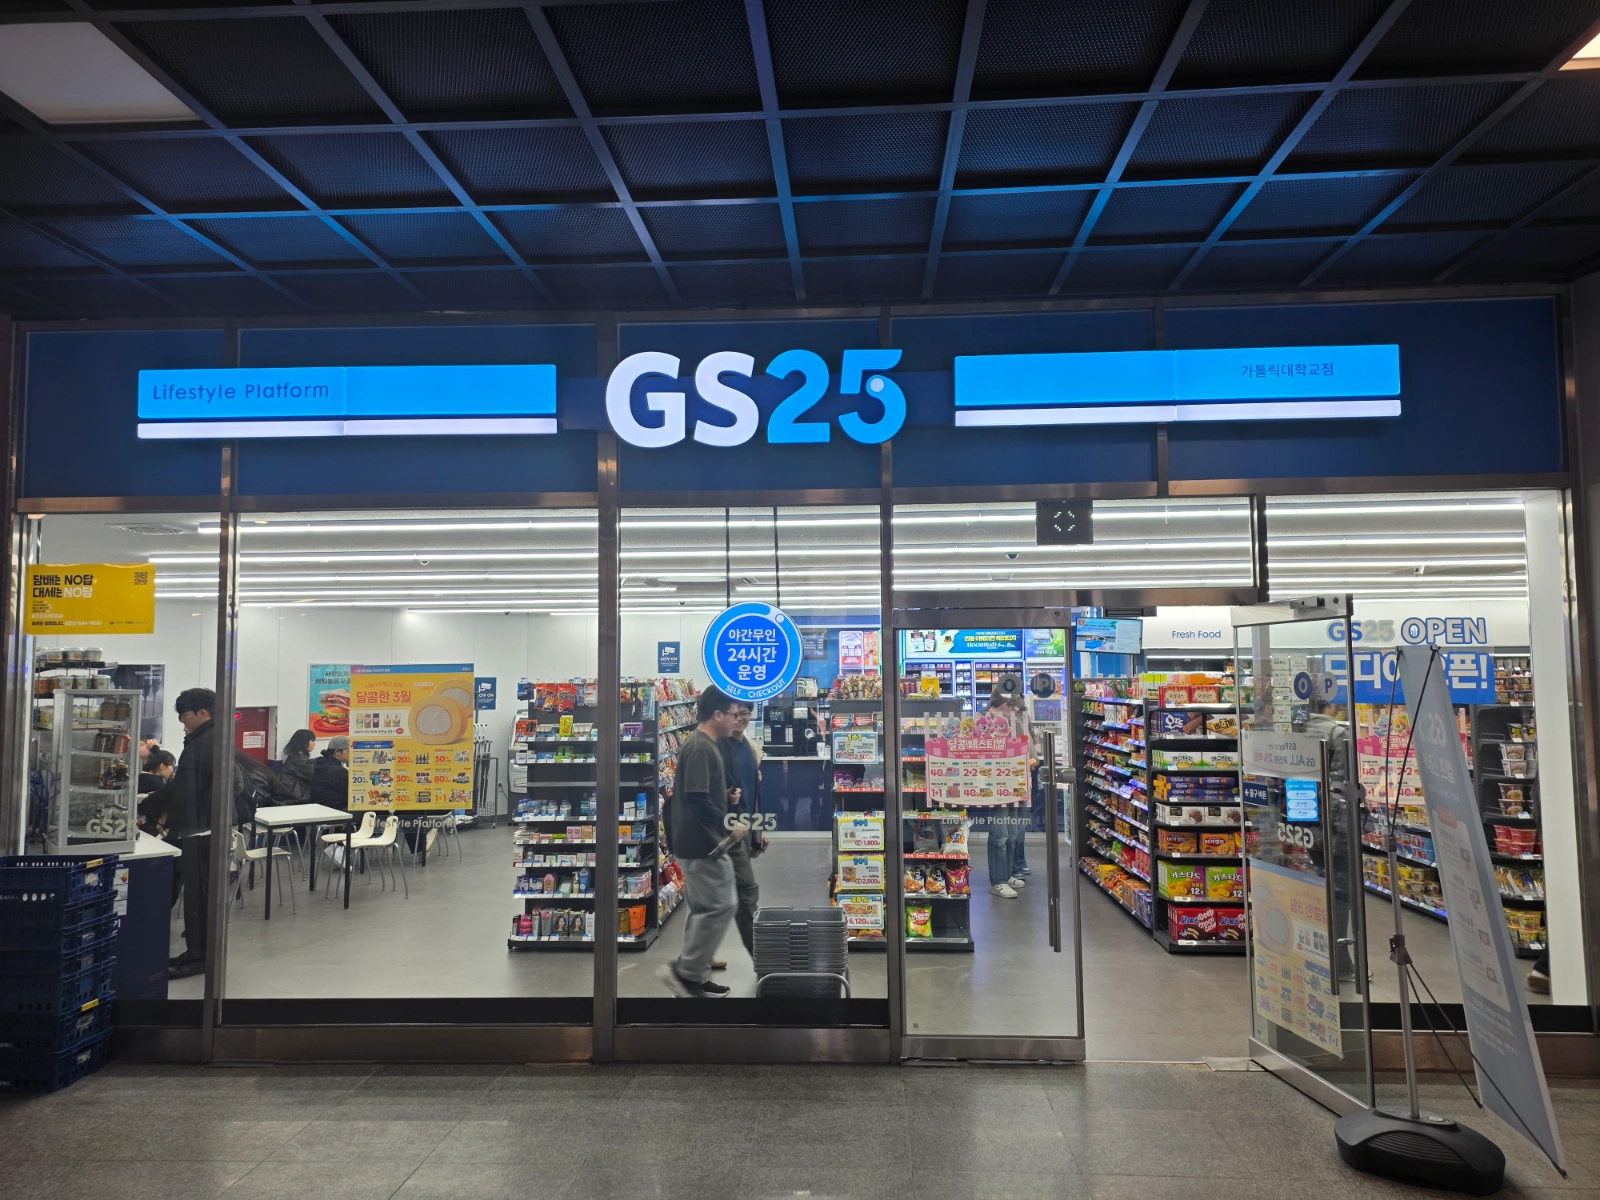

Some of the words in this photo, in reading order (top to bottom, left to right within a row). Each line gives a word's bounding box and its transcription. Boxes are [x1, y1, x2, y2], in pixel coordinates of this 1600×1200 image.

[1241, 362, 1334, 378] 가톨릭대학교점
[153, 384, 236, 405] Lifestyle
[244, 382, 330, 399] Platform
[605, 349, 907, 448] GS25
[33, 574, 61, 586] 담배는
[32, 587, 62, 598] 대세는
[728, 628, 776, 642] 야간무인
[1172, 630, 1195, 639] Fresh
[1198, 630, 1221, 638] Food
[1326, 620, 1396, 642] GS25
[1401, 616, 1488, 645] OPEN
[728, 646, 777, 663] 24시간
[737, 664, 767, 681] 운영
[726, 685, 742, 696] SELF
[748, 678, 786, 698] CHECKOUT
[1325, 678, 1332, 693] P
[356, 691, 390, 704] 달콤한
[393, 690, 411, 703] 3월
[947, 738, 1006, 751] 달콤페스티벌
[931, 789, 942, 797] 1+1
[724, 813, 777, 830] GS25
[988, 816, 1031, 825] Platform
